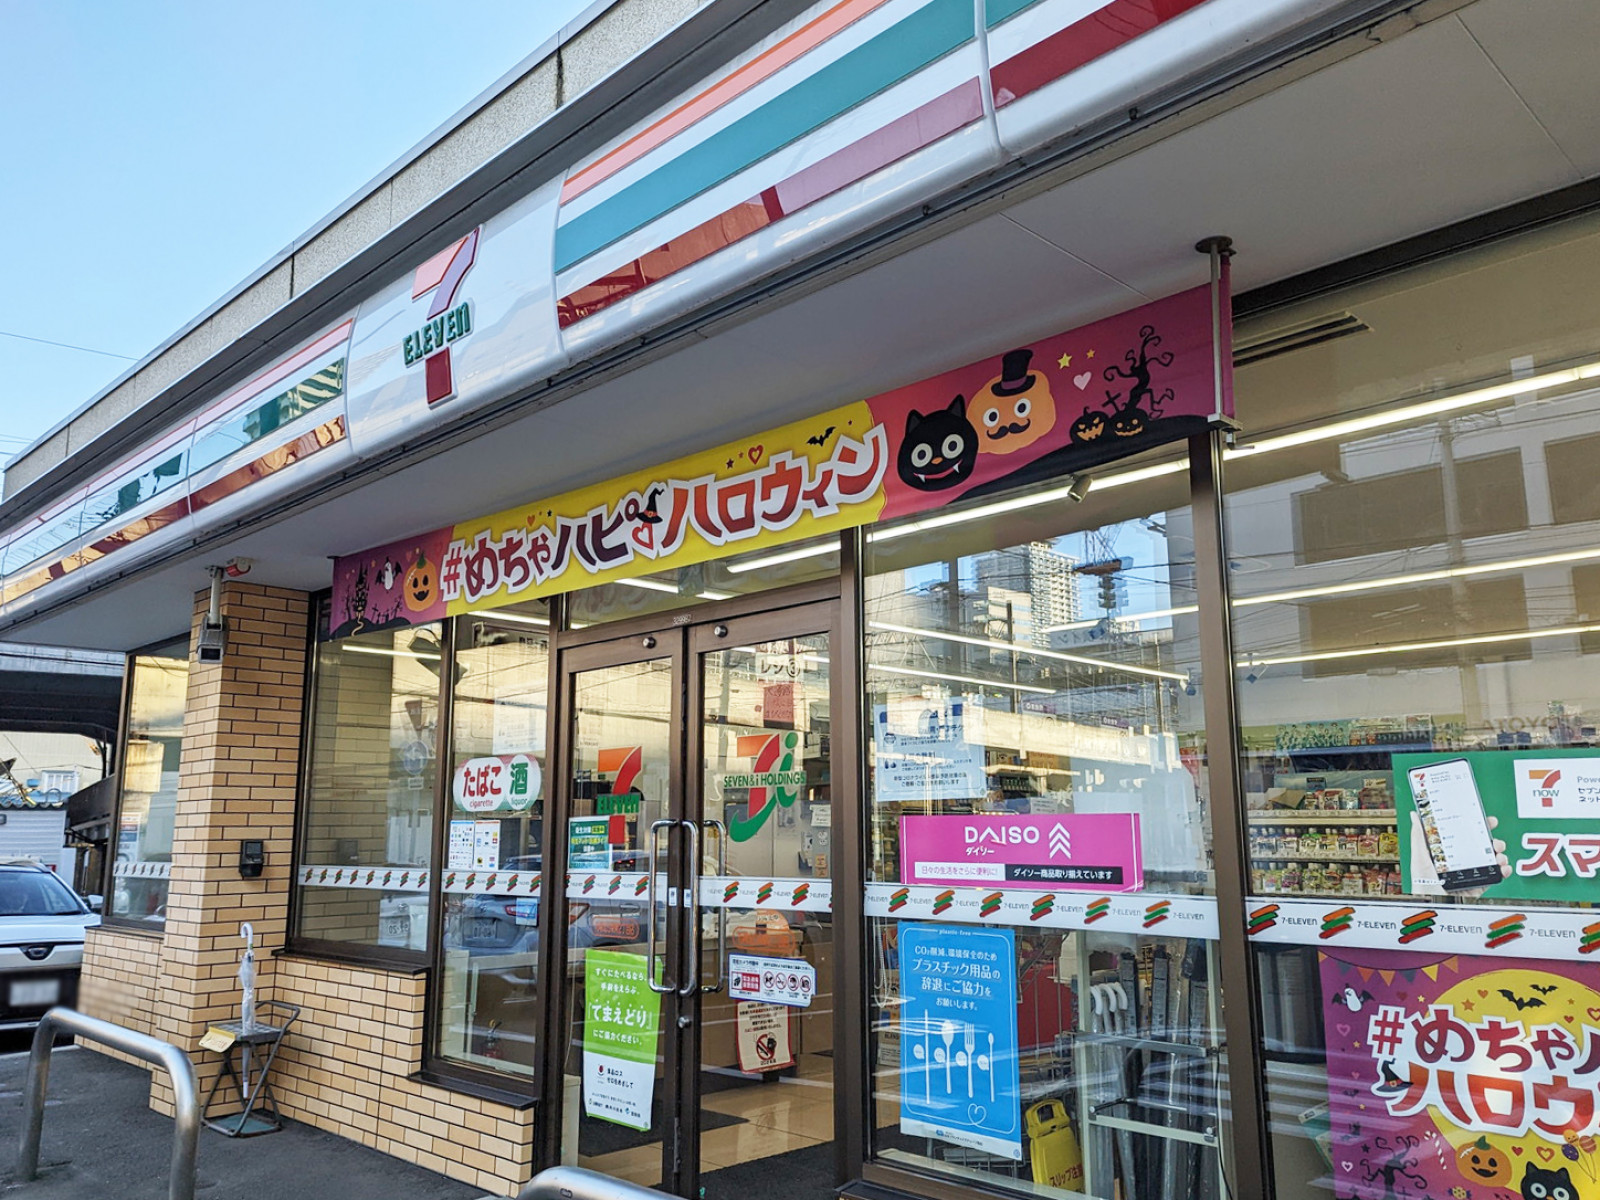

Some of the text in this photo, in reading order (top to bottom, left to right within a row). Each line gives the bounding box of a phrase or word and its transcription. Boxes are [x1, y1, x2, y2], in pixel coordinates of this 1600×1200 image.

[463, 762, 529, 797] たばこ 酒
[761, 771, 807, 786] HOLDINGS
[1533, 789, 1560, 797] now
[469, 797, 528, 808] cigarette liquor
[964, 825, 1040, 844] DAISO
[965, 846, 995, 856] ダイソー
[1013, 868, 1113, 880] ダイソー商品取り揃えています
[595, 967, 647, 981] すぐにたべるなら、
[912, 958, 1001, 979] プラスチック用品の
[921, 976, 992, 997] 辞退にご協力を
[935, 997, 978, 1011] お願いします。
[592, 1029, 643, 1045] にご協力ください。
[1390, 1061, 1600, 1136] ハロウ
